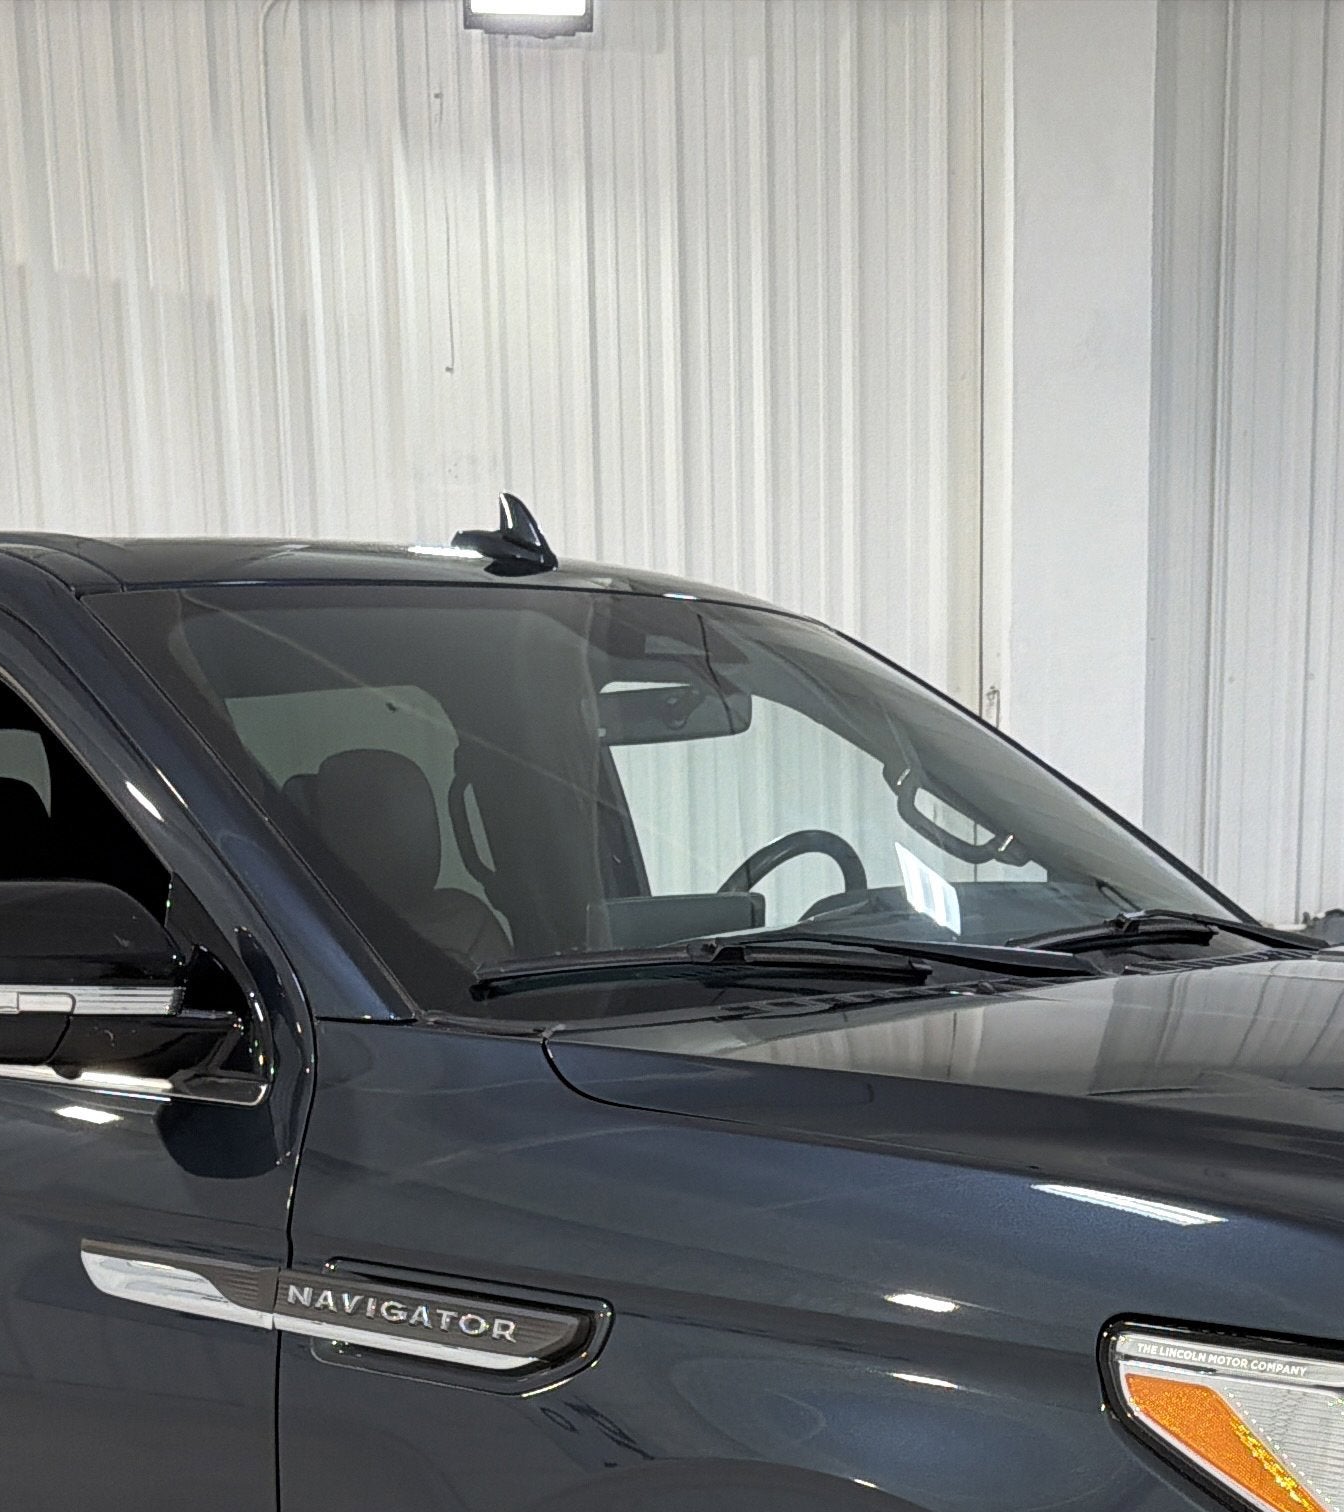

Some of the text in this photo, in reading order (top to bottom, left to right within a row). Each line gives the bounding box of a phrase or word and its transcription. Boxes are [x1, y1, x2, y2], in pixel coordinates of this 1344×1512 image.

[287, 1283, 518, 1344] NAVIGATOR
[1137, 1343, 1307, 1377] THE LINCOLN MOTOR COMPANY
